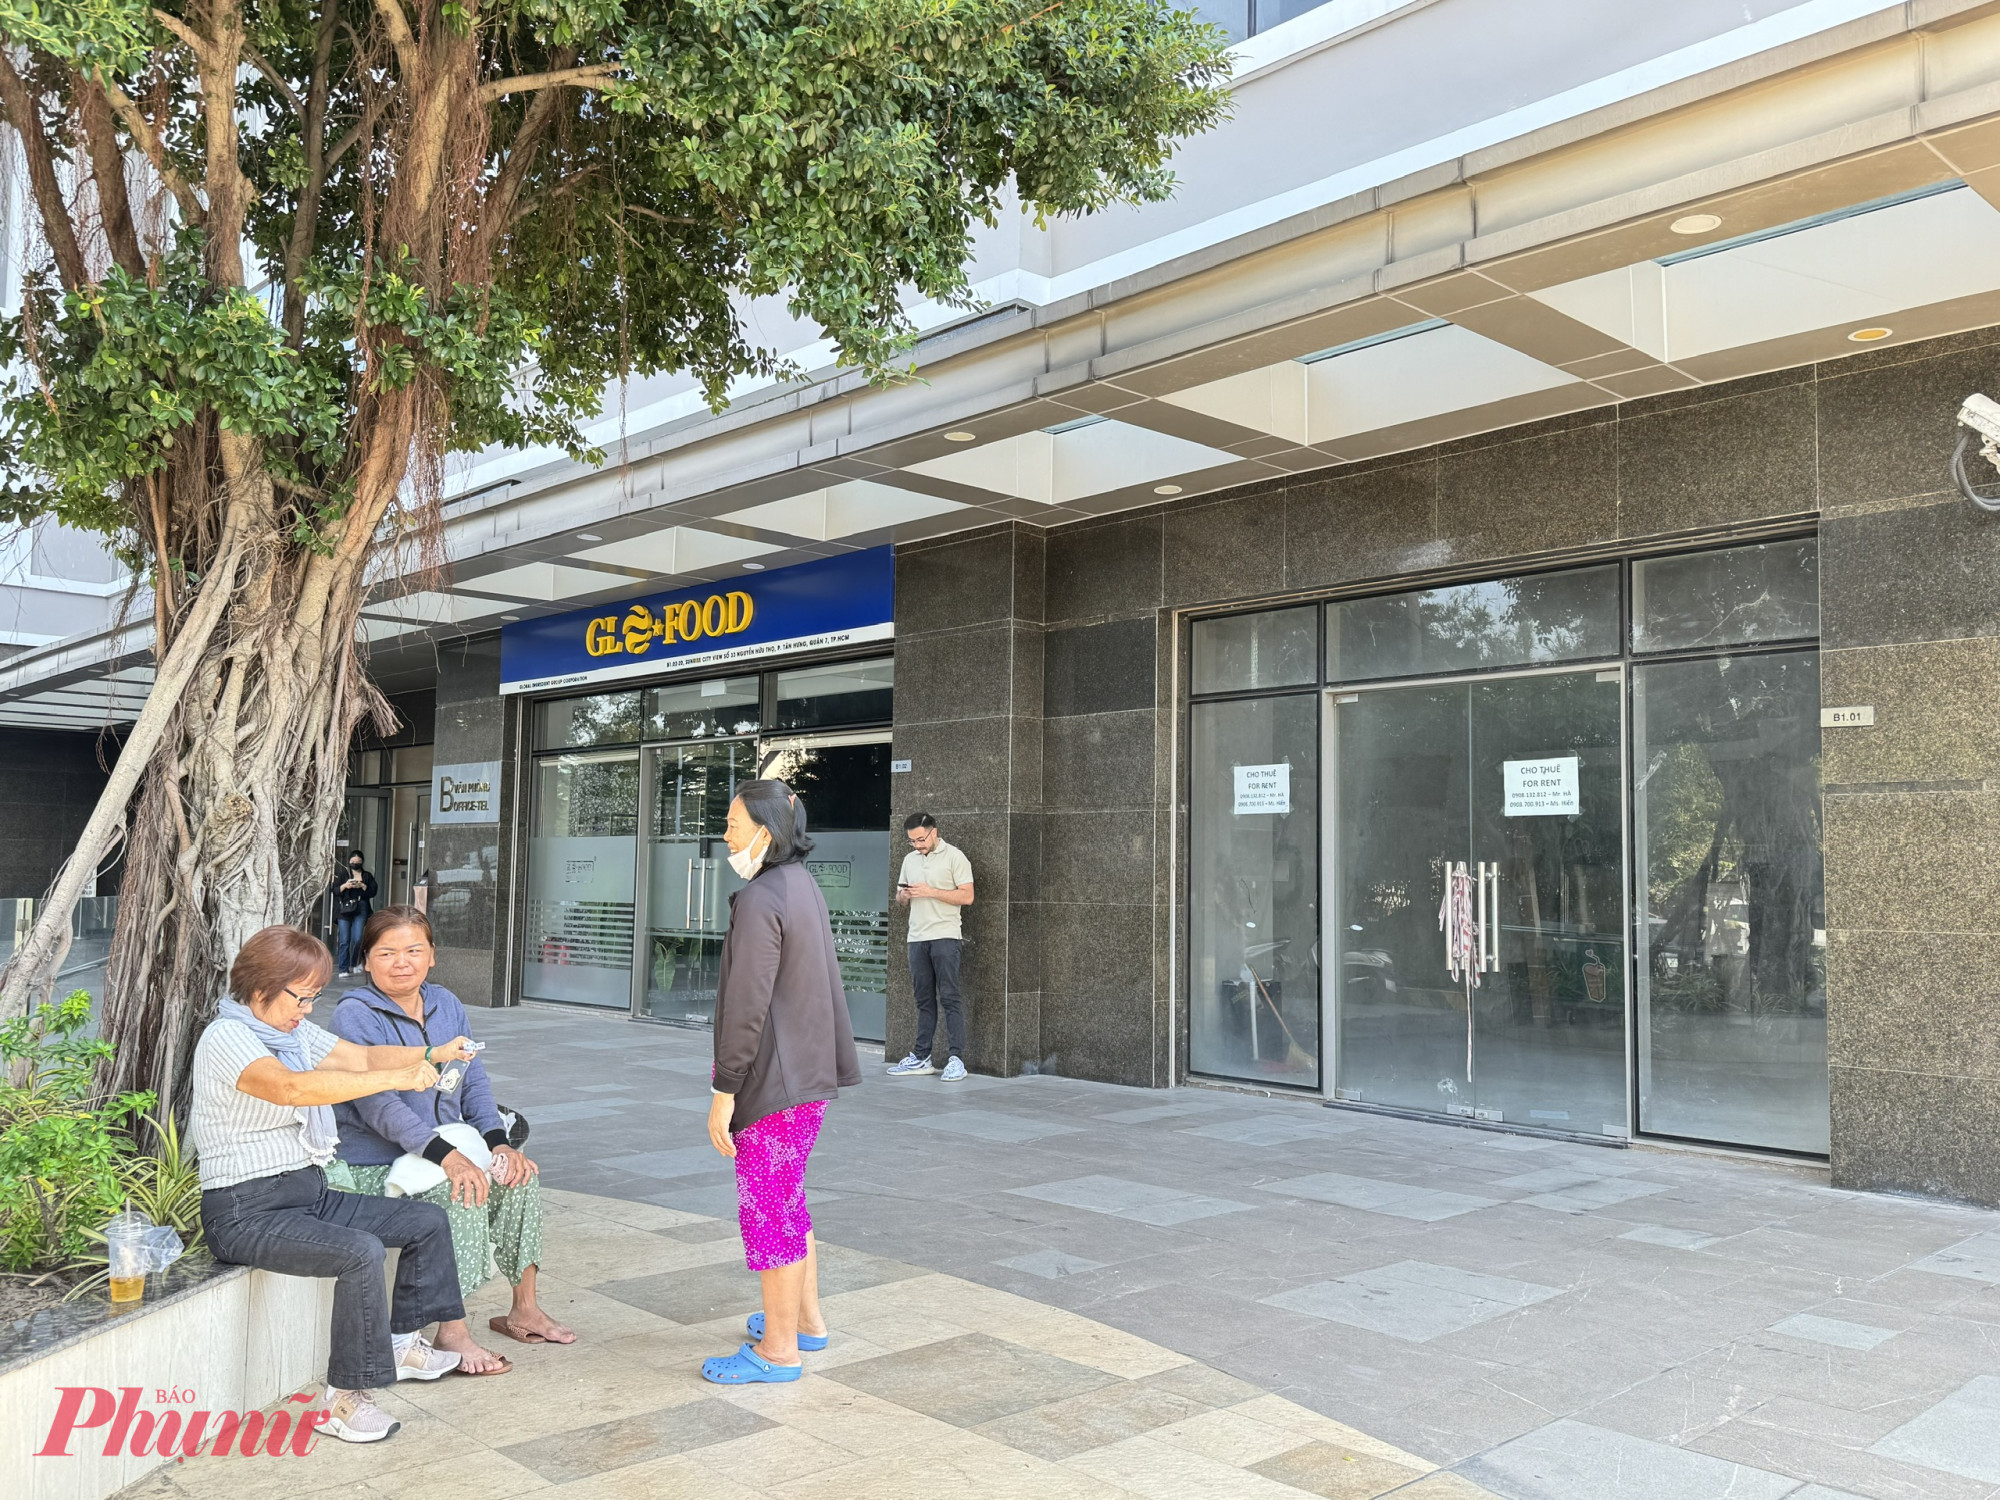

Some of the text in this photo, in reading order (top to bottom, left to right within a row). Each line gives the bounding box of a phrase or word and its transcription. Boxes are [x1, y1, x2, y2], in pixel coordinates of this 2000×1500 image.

[662, 590, 754, 645] FOOD
[702, 655, 711, 663] CITY
[712, 653, 723, 661] VIEW
[737, 647, 754, 657] NGUYỄN
[783, 642, 792, 650] TÂN
[809, 637, 824, 647] QUẬN
[830, 634, 850, 643] TP.HCM
[1833, 712, 1860, 721] B1.01
[1261, 769, 1276, 777] THUÊ
[1540, 764, 1560, 773] THUÊ
